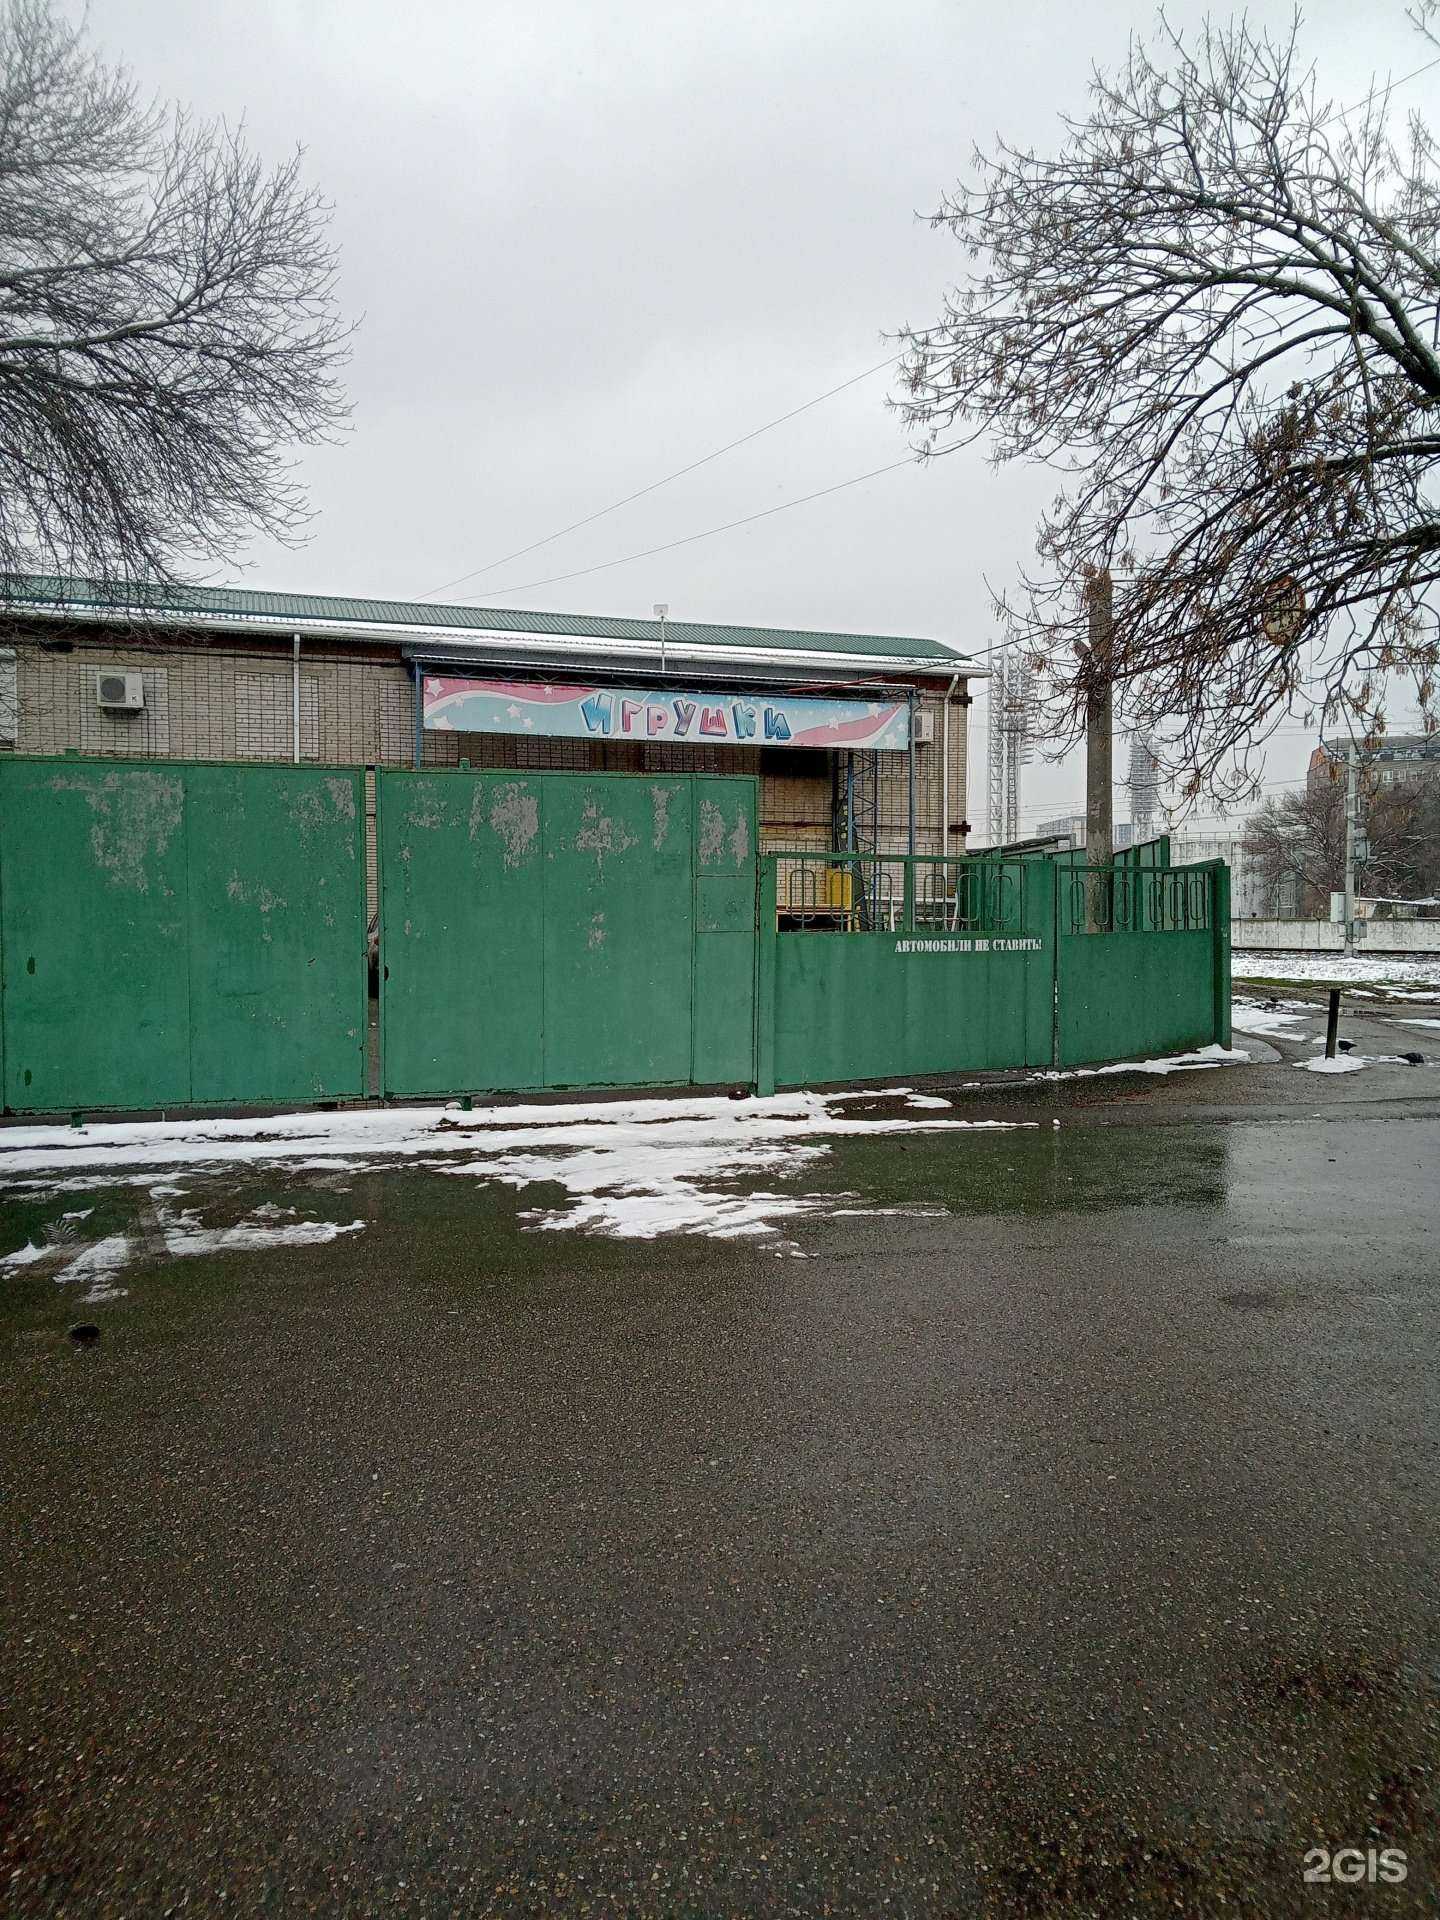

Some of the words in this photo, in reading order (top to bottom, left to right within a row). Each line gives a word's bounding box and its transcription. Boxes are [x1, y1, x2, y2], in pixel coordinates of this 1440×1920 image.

[581, 692, 791, 740] ИГРУШКИ
[895, 939, 972, 953] АВТОМОБИЛИ
[975, 939, 990, 952] НЕ
[992, 938, 1042, 951] СТАВИТЬ!
